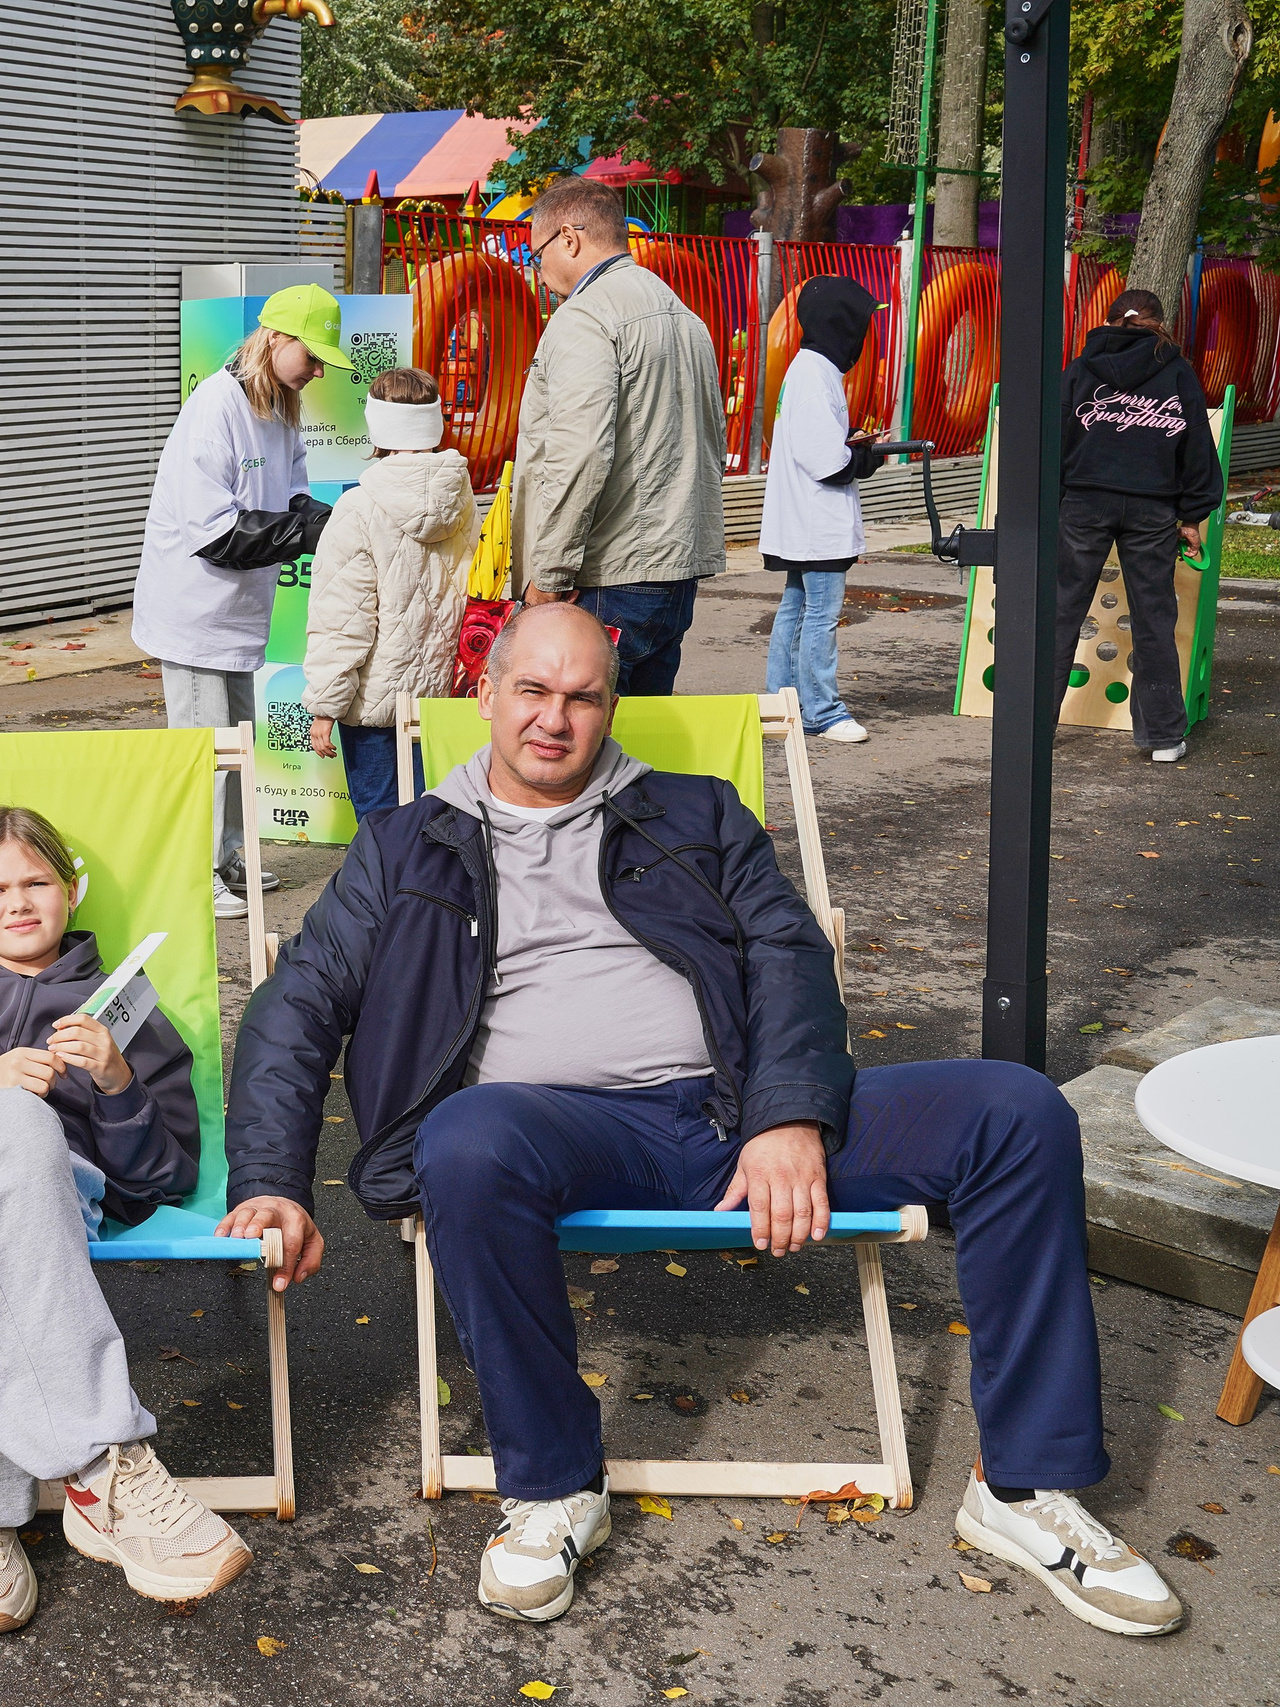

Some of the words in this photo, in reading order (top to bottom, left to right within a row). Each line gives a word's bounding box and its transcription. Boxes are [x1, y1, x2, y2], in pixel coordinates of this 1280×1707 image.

[1156, 395, 1184, 415] for
[1075, 401, 1187, 437] Everything
[300, 422, 336, 433] ывайся
[304, 438, 324, 448] ера
[335, 435, 372, 446] Сберба
[282, 763, 302, 771] Игра
[264, 785, 288, 797] буду
[300, 787, 326, 797] 2050
[328, 791, 352, 801] году
